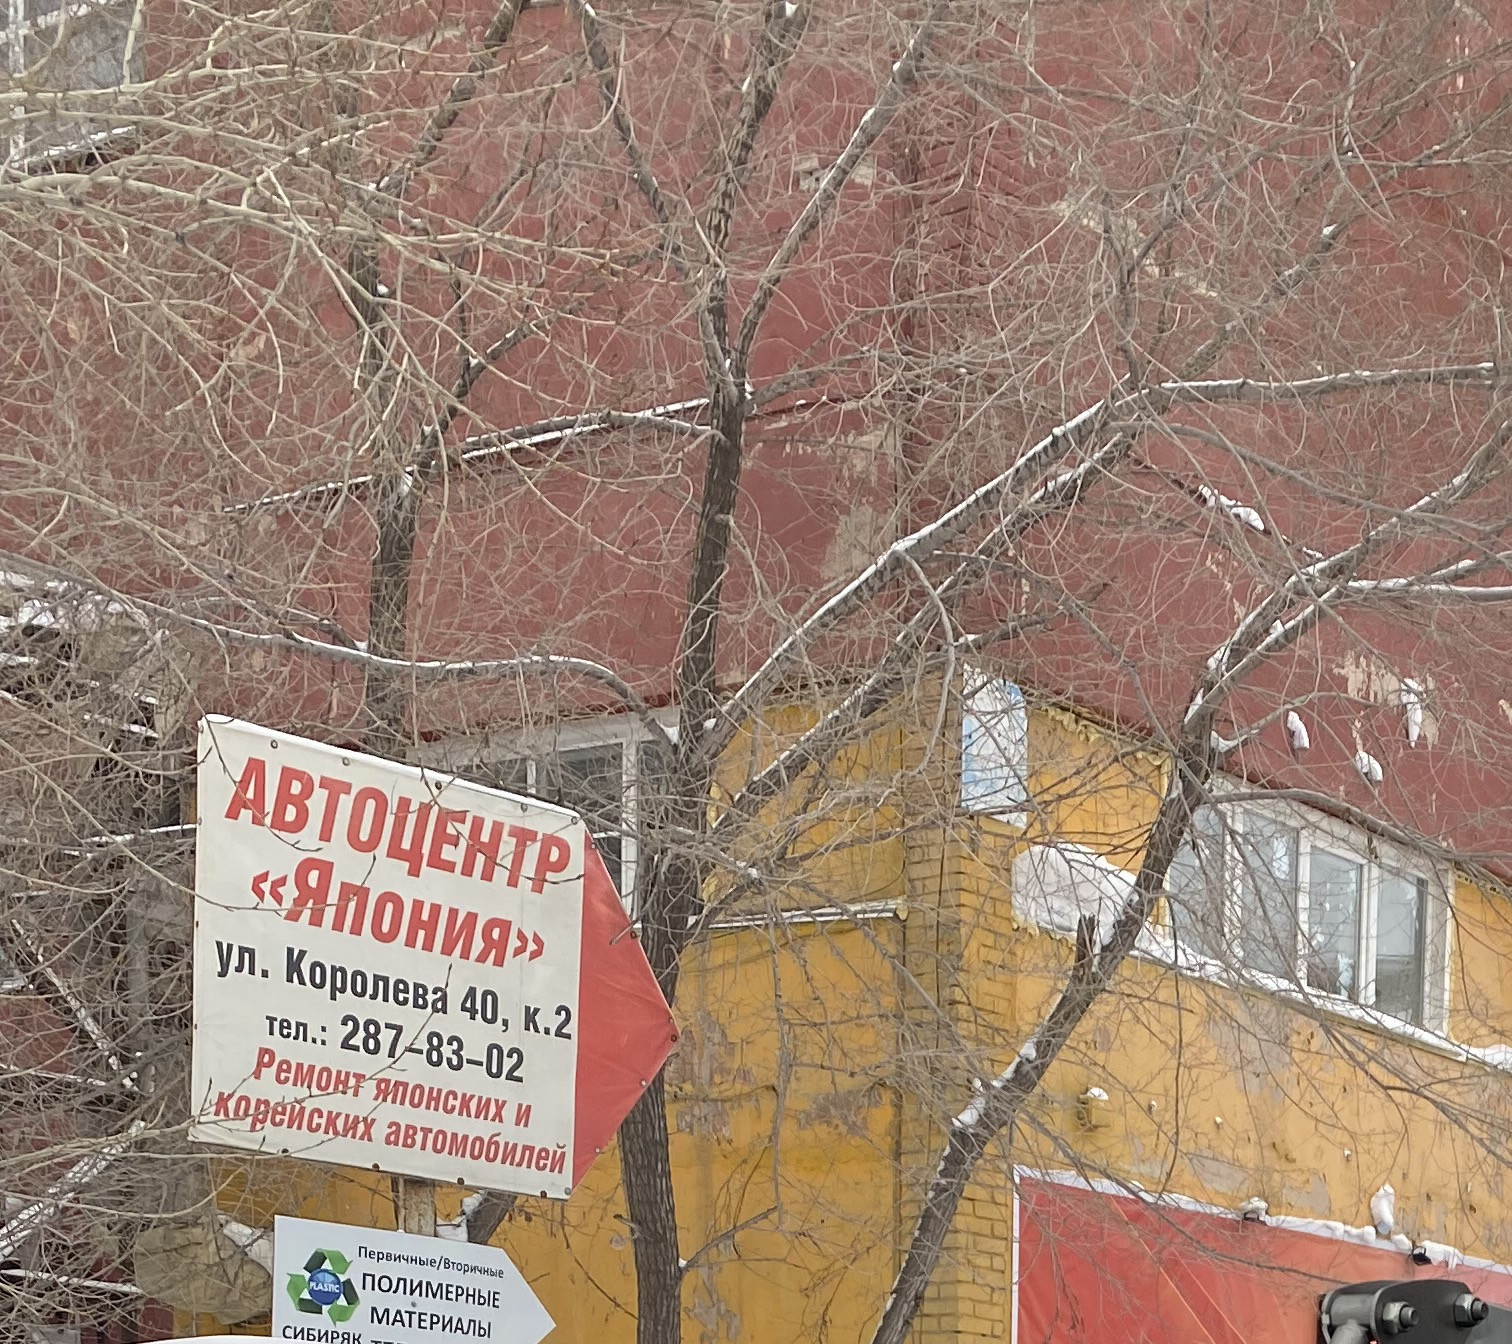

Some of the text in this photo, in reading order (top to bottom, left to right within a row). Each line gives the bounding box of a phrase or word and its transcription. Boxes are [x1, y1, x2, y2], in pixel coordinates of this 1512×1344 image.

[225, 756, 571, 895] АВТОЦЕНТР
[215, 940, 573, 1041] ул. Королева 40, к.2
[266, 1014, 525, 1083] тел.: 287-83-02
[253, 1047, 532, 1128] Ремонт японских и
[214, 1090, 567, 1176] корейских автомобилей
[309, 1281, 340, 1293] PLASTIC
[358, 1246, 504, 1279] Первичные/Вторичные
[361, 1272, 501, 1309] ПОЛИМЕРНЫЕ
[370, 1306, 492, 1338] МАТЕРИАЛЫ
